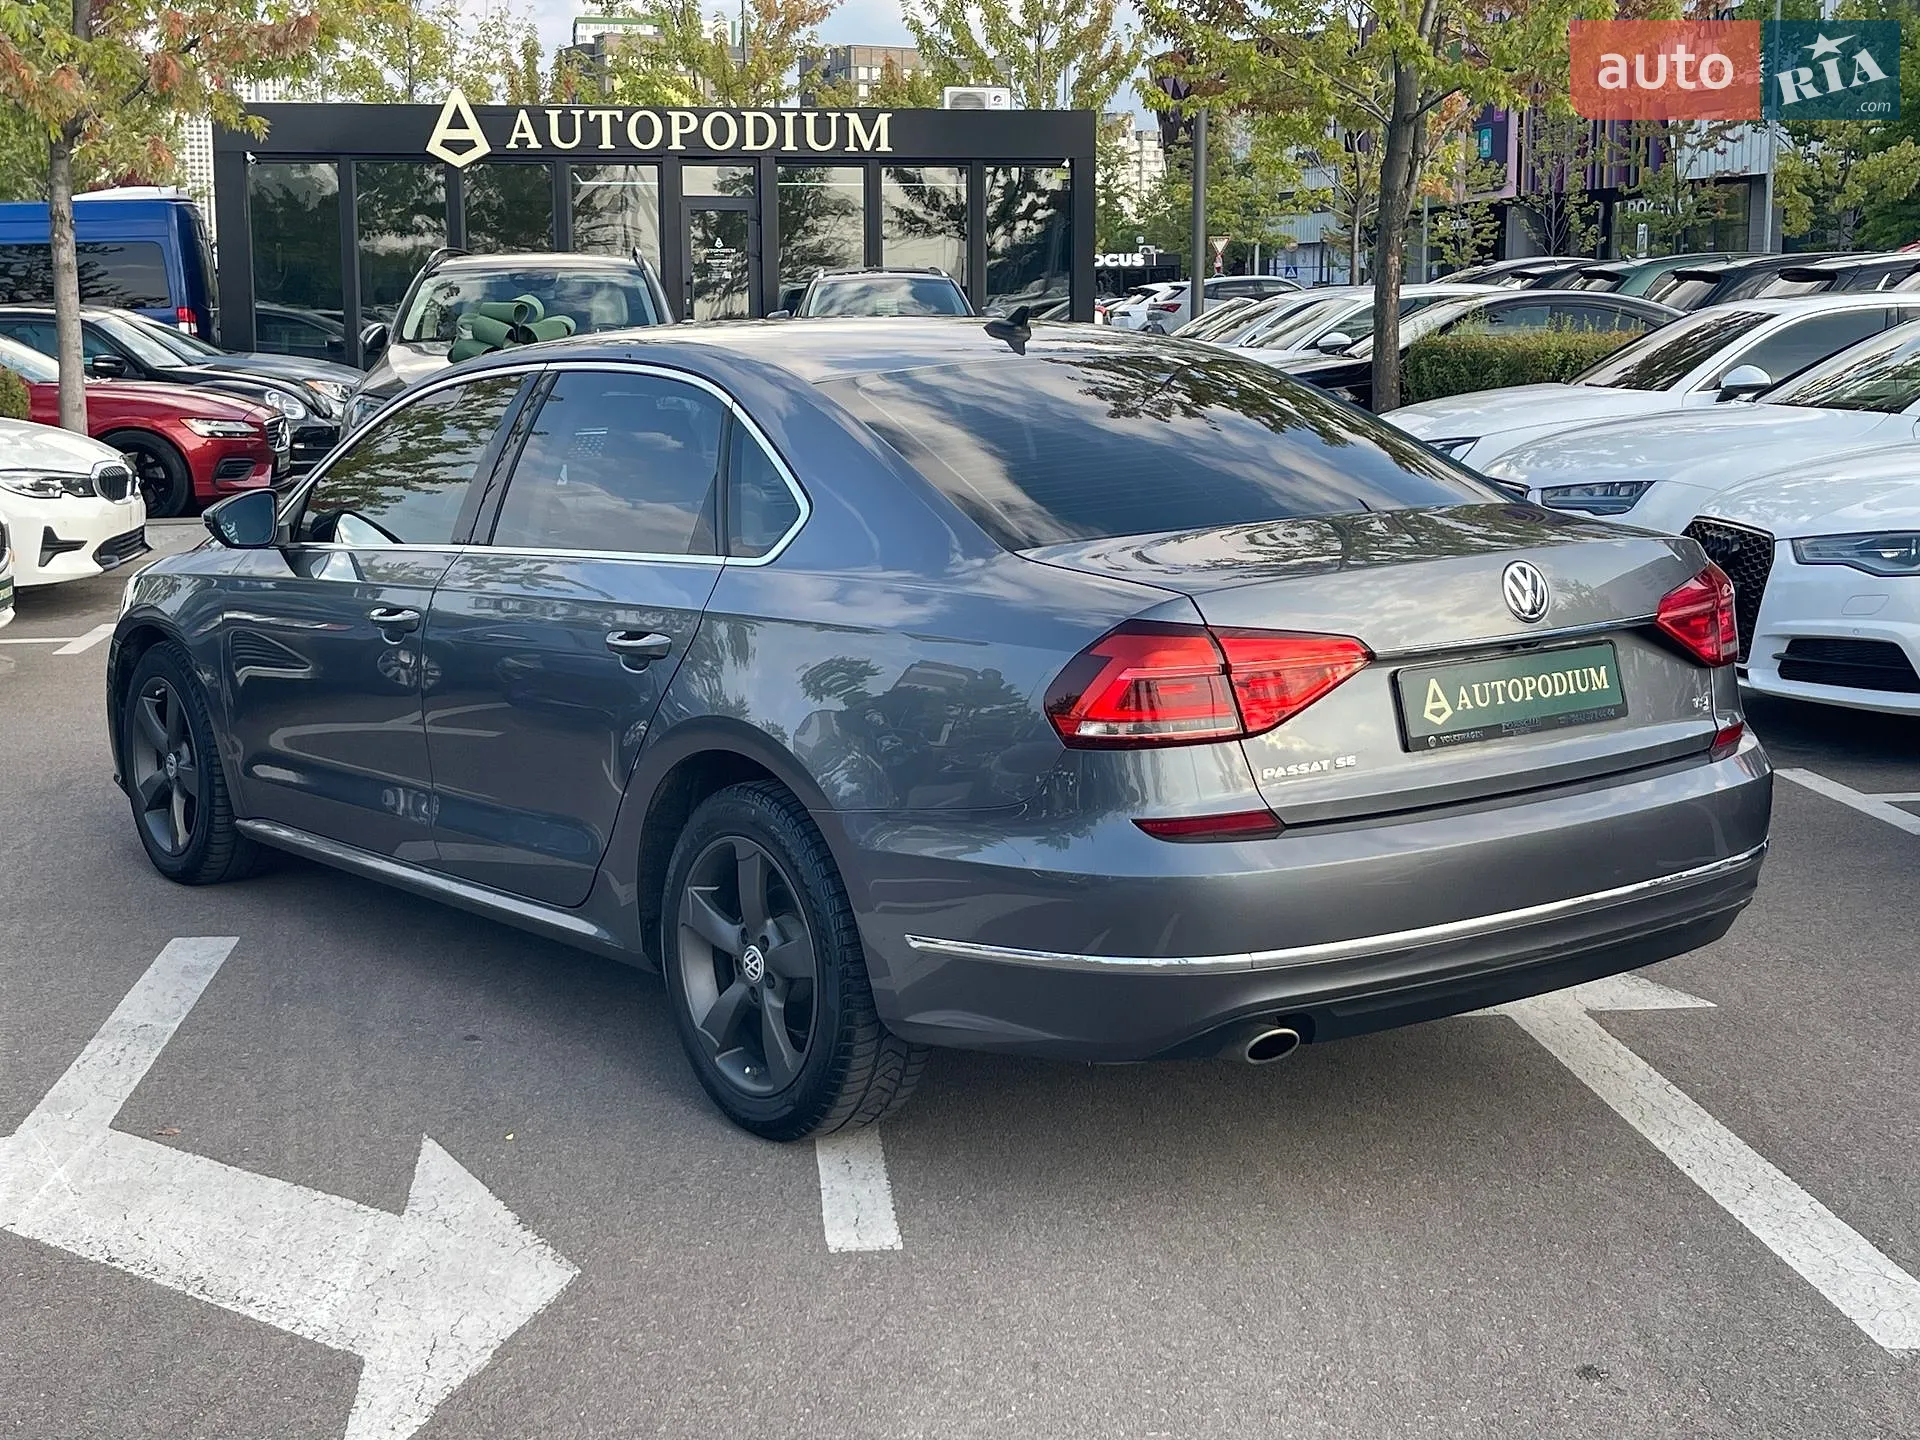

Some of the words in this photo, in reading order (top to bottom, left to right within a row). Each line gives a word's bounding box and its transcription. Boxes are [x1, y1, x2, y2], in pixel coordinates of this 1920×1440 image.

[506, 109, 893, 153] AUTOPODIUM
[1456, 665, 1610, 711] AUTOPODIUM
[1262, 760, 1330, 780] PASSAT
